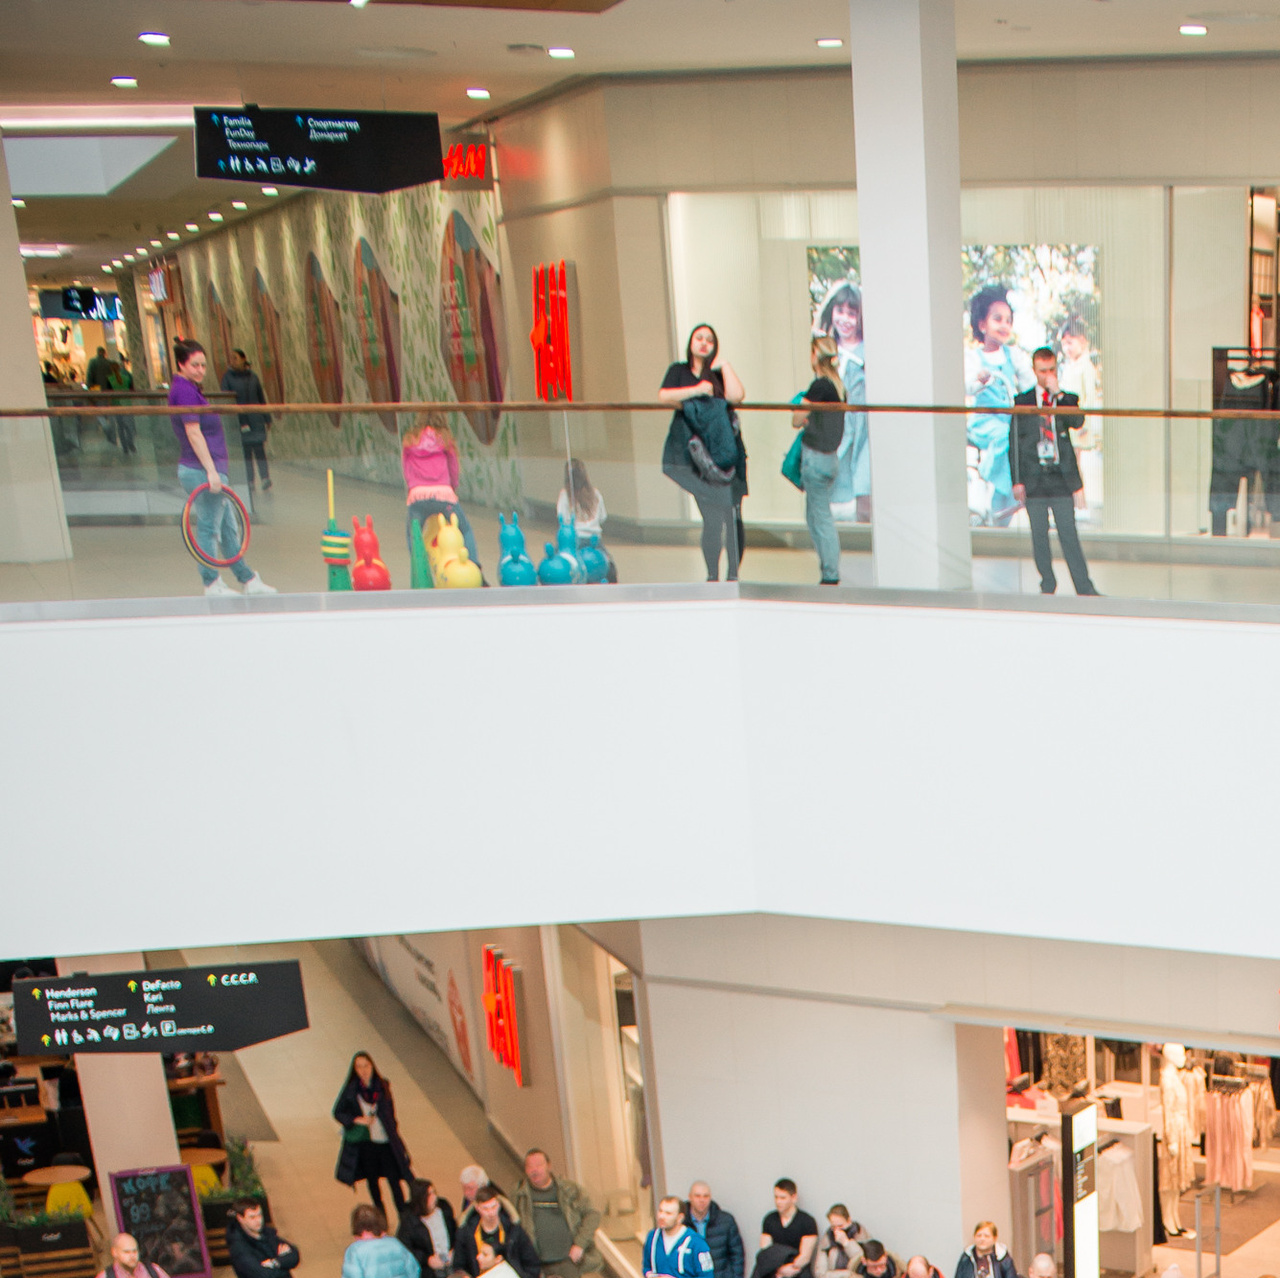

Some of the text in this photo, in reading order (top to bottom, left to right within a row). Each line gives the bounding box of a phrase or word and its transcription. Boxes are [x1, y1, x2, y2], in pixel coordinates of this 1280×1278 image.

[223, 116, 252, 127] Familia
[307, 117, 360, 131] Спортмастер
[225, 128, 255, 139] FunDay
[227, 139, 269, 151] Технопарк
[442, 143, 486, 180] H&M
[142, 979, 182, 991] DeFacto
[45, 986, 98, 1000] Henderson
[143, 992, 164, 1003] Kari
[48, 998, 94, 1011] Finn Flare
[146, 1004, 176, 1015] Лента
[50, 1011, 79, 1023] Marks
[89, 1007, 127, 1020] Spencer
